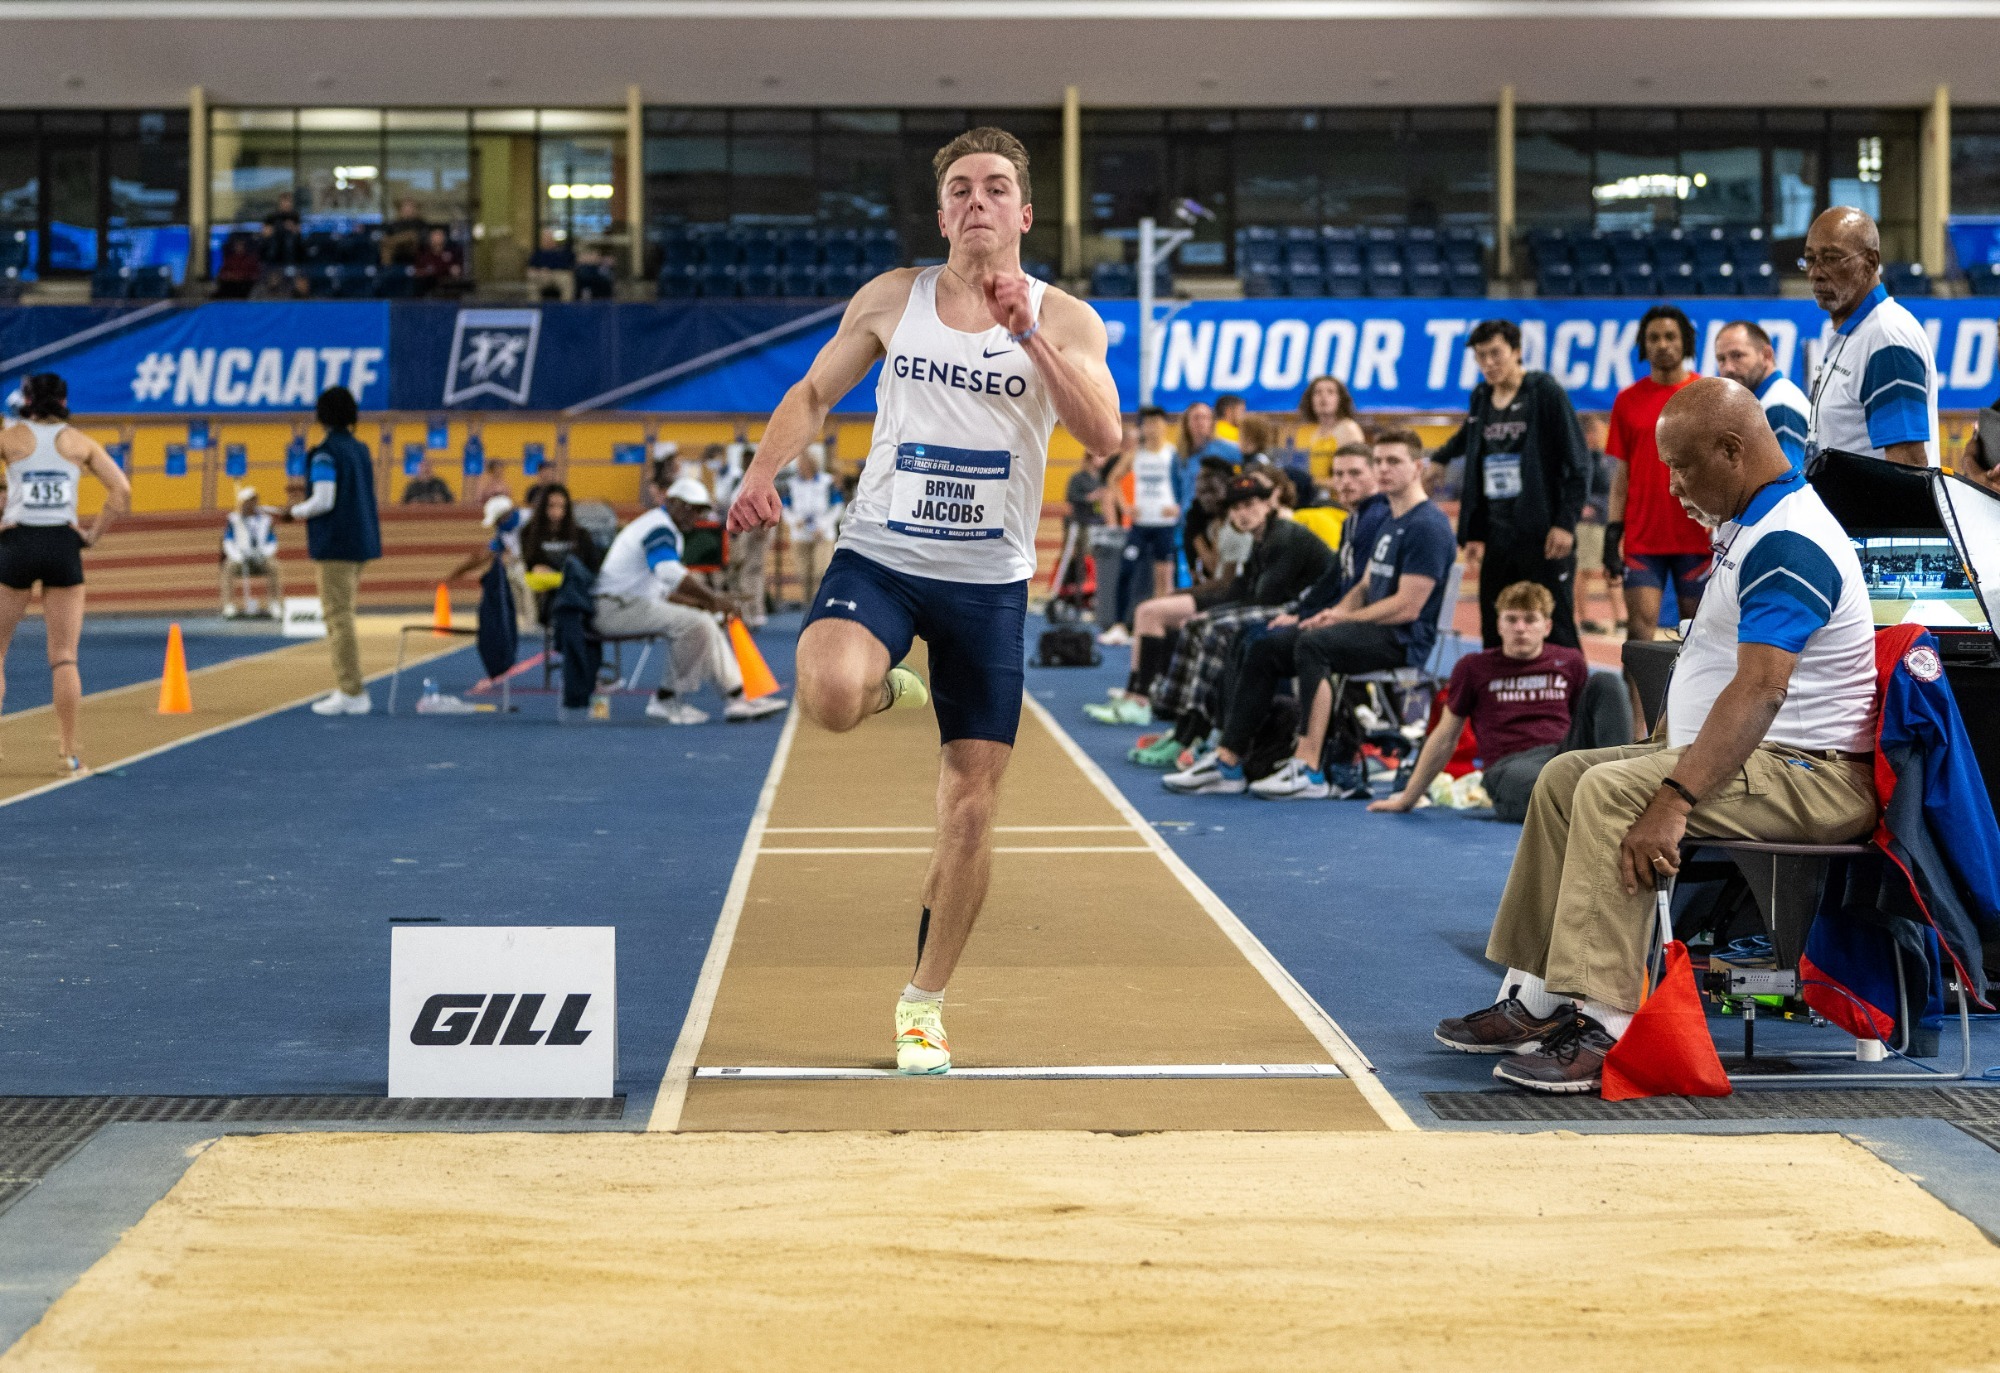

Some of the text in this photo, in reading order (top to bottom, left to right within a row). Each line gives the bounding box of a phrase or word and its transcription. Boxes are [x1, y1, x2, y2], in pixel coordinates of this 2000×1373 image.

[131, 347, 384, 406] #NCAATF
[894, 355, 1027, 398] GENESEO
[914, 460, 933, 469] TRACK
[938, 463, 955, 471] FIELD
[955, 465, 1006, 475] CHAMPIONSHIPS
[30, 482, 64, 501] 435
[925, 480, 976, 500] BRYAN
[912, 499, 985, 523] JACOBS
[410, 993, 593, 1046] GILL
[912, 1017, 936, 1027] NIKE
